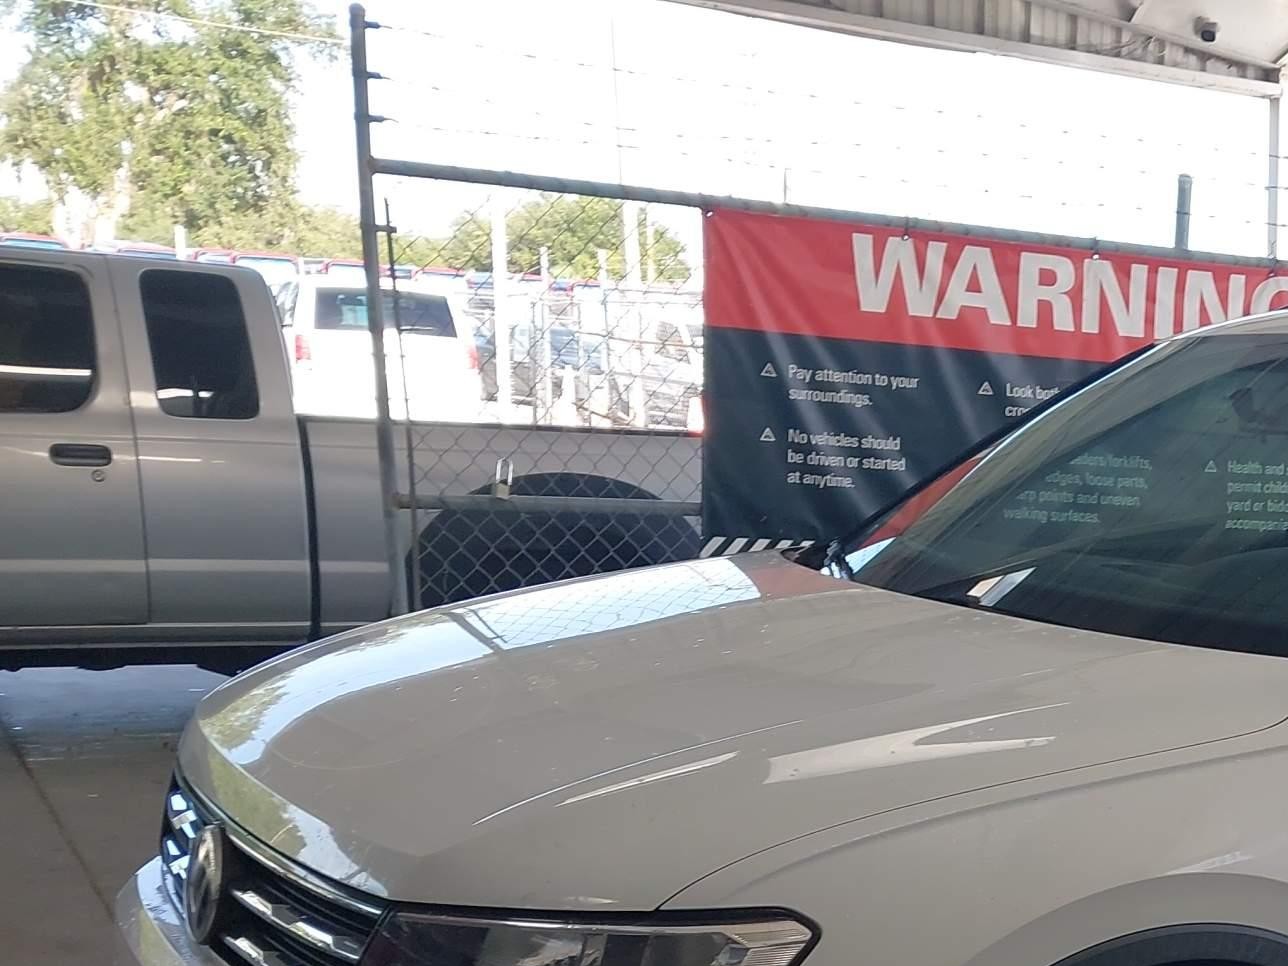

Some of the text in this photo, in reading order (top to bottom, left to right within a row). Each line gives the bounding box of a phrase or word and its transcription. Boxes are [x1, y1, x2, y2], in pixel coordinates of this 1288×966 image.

[788, 365, 920, 390] Pay attention to your
[788, 388, 872, 407] surroundings.
[1006, 383, 1034, 398] Look
[788, 429, 901, 450] No vehicles should
[787, 450, 906, 471] be driven or started
[1228, 460, 1263, 474] Health
[1264, 463, 1285, 475] and
[787, 471, 855, 488] at anytime.
[1227, 481, 1262, 494] permit
[1226, 500, 1251, 513] yard
[1253, 502, 1265, 512] or
[1003, 508, 1048, 523] walking
